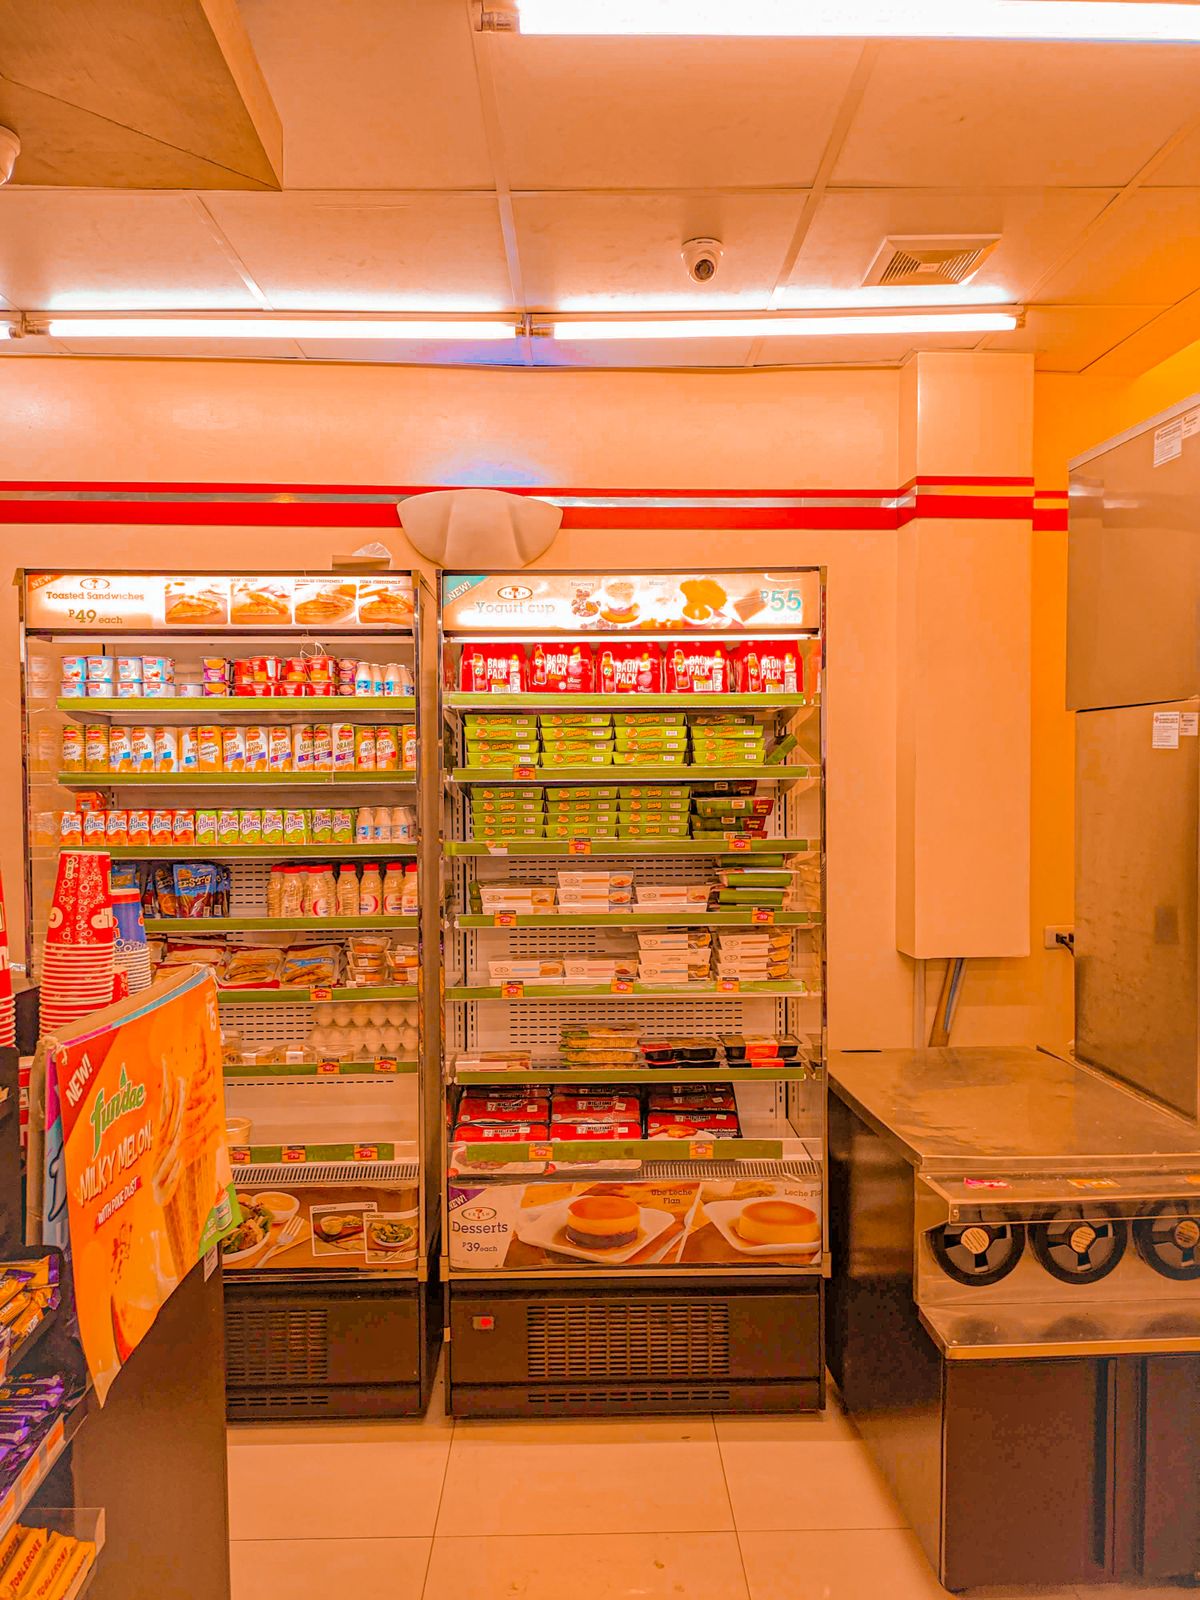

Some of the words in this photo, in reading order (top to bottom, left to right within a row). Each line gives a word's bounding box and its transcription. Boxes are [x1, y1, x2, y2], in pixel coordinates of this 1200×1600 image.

[46, 592, 84, 600] Toasted
[87, 592, 144, 600] Sandwiches
[447, 580, 472, 600] NEW!
[476, 602, 524, 614] Yogurt
[527, 604, 556, 614] cup
[98, 616, 123, 624] each
[487, 668, 508, 679] PACK
[546, 664, 568, 676] PACK
[689, 666, 710, 676] PACK
[762, 668, 782, 679] PACK
[616, 672, 638, 684] PACK
[65, 1054, 94, 1107] NEW!
[79, 1152, 115, 1206] MILKY
[117, 1120, 152, 1171] MELON
[784, 1188, 809, 1197] Leche
[452, 1222, 508, 1234] Desserts
[480, 1244, 498, 1252] each
[10, 1538, 42, 1593] TOBLERONE
